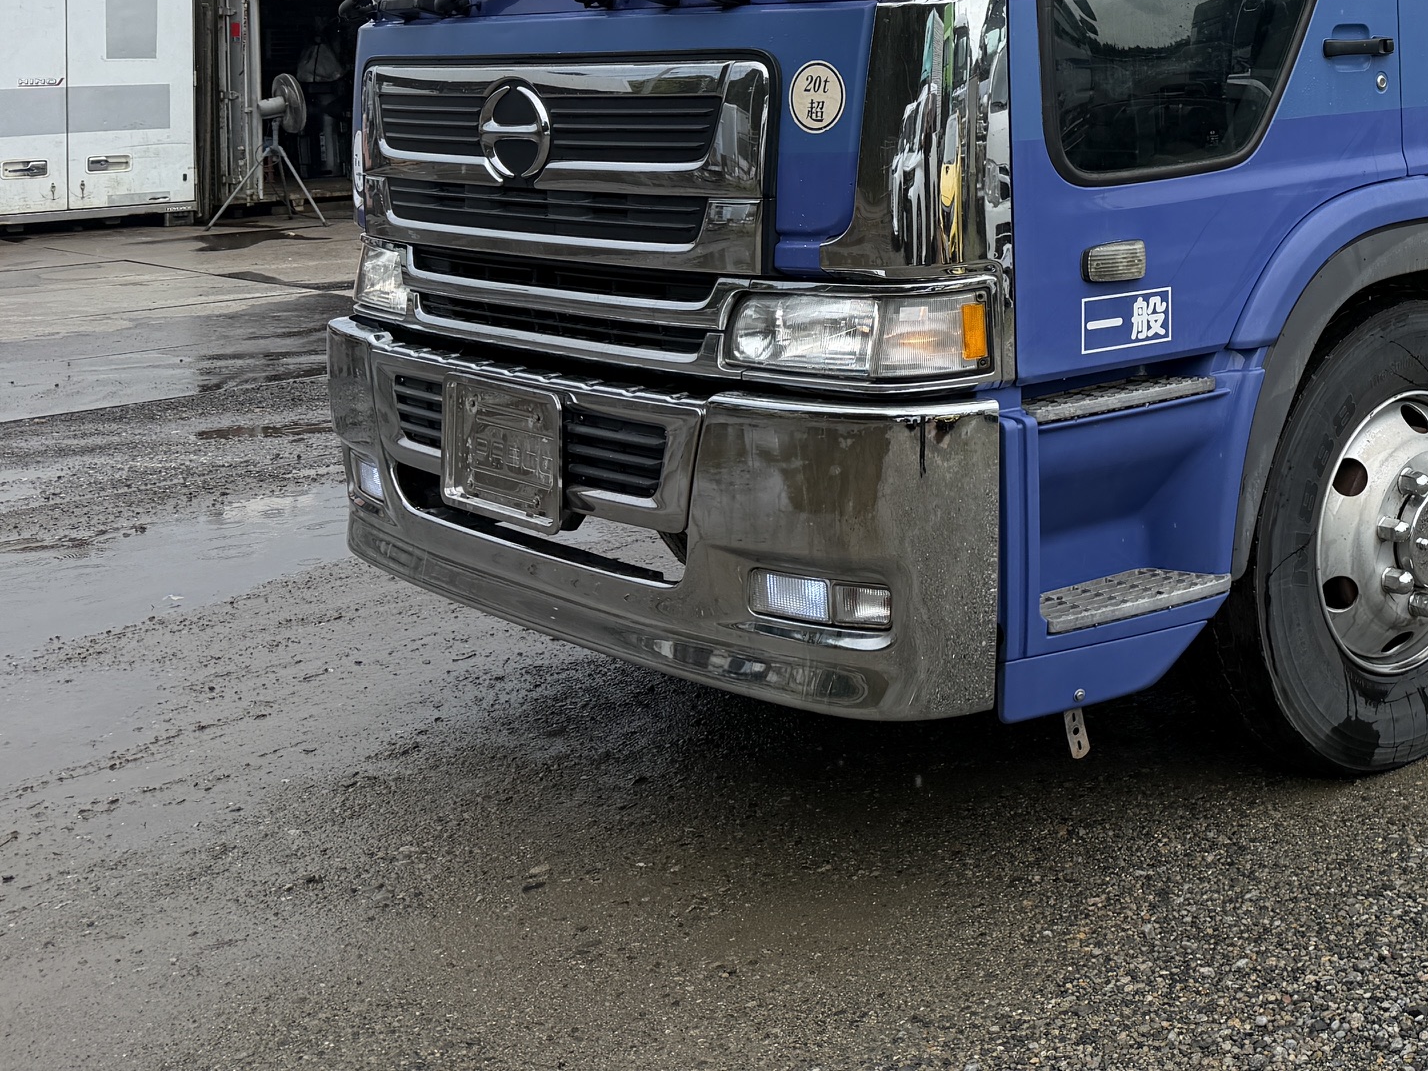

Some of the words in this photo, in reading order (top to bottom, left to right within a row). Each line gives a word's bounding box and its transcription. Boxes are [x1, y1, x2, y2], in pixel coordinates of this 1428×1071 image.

[17, 78, 57, 86] HINO
[803, 74, 831, 94] 20t
[805, 98, 826, 123] 超
[1086, 295, 1168, 340] 一般
